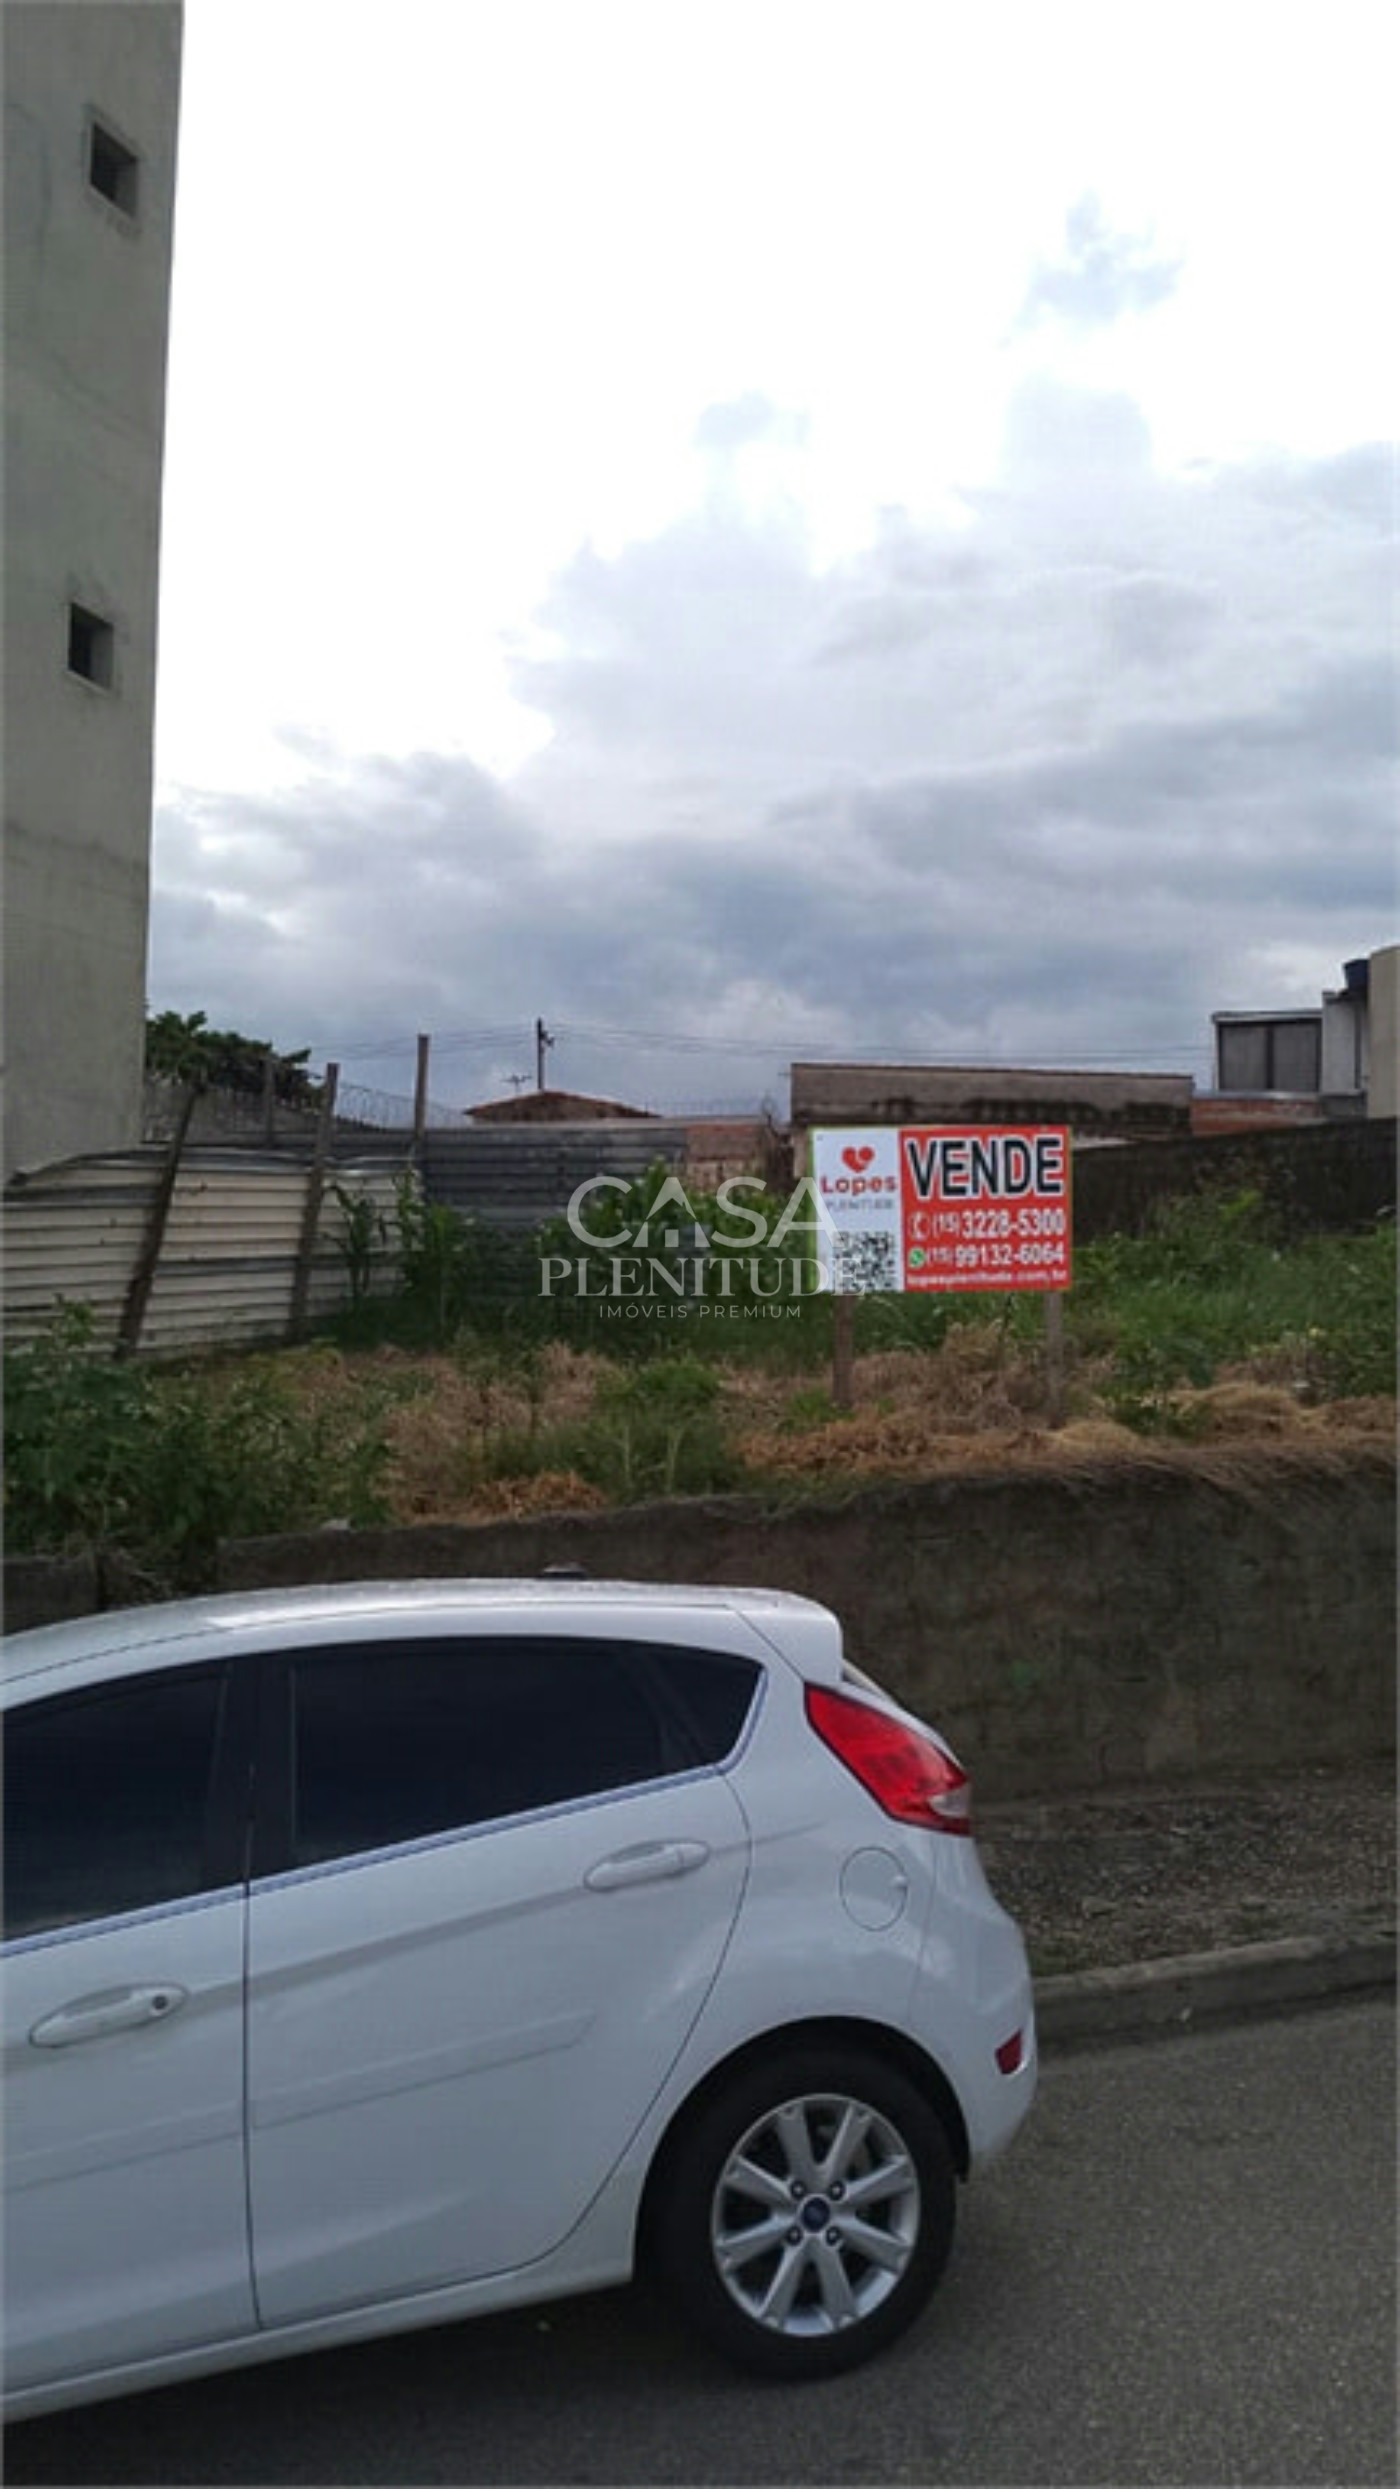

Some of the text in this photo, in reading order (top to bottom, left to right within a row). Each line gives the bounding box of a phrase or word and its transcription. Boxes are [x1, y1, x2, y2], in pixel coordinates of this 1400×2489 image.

[906, 1136, 1064, 1199] VENDE
[821, 1175, 896, 1196] Lopes
[961, 1208, 1066, 1239] 3228-5300
[955, 1242, 1065, 1268] 99132-6064
